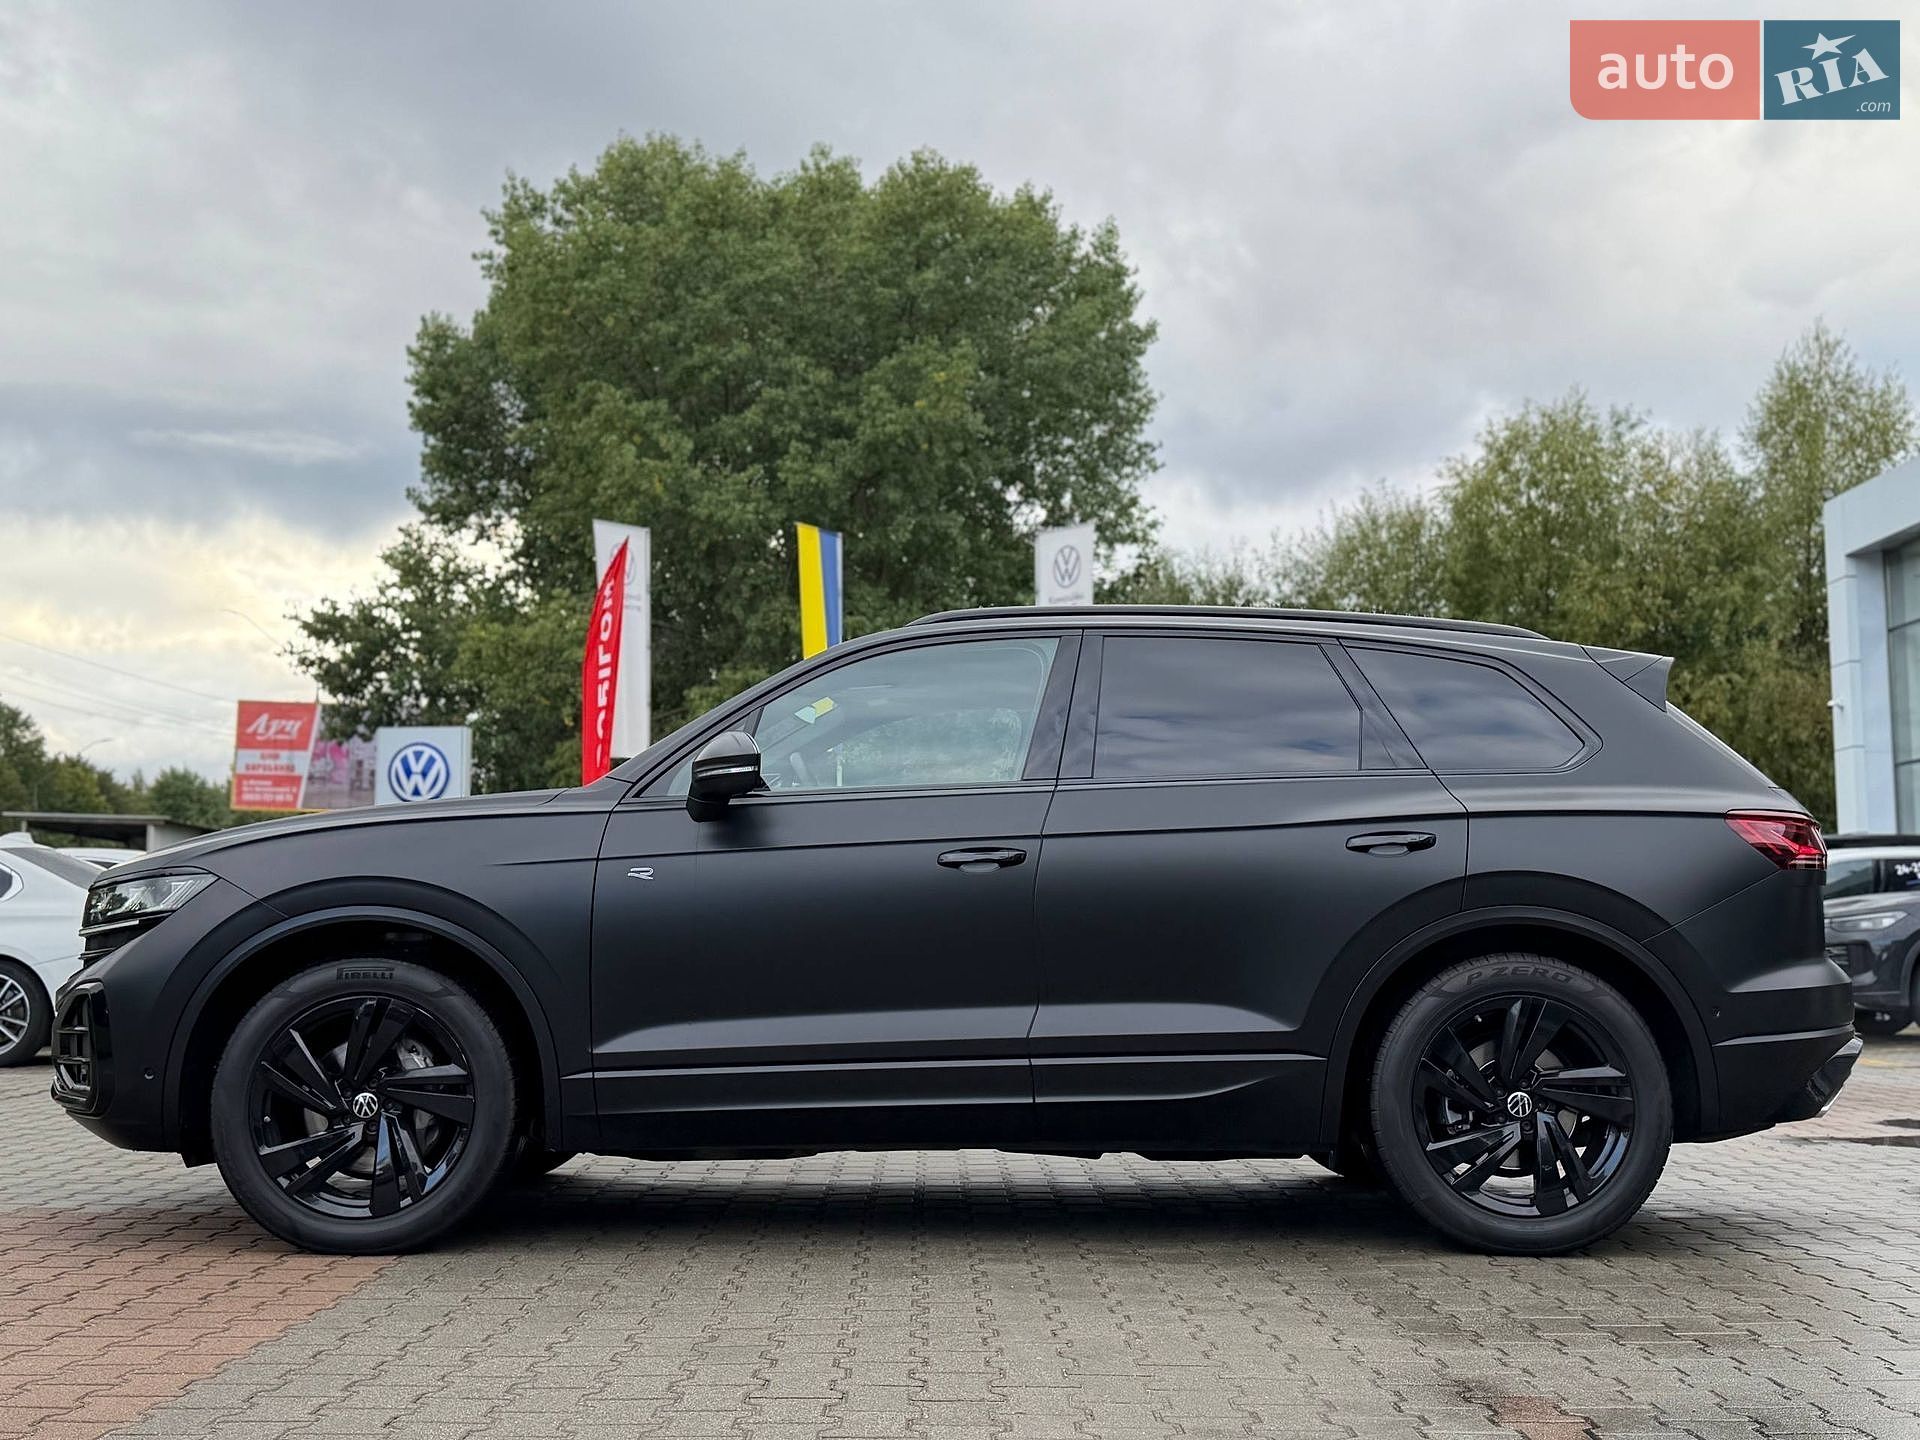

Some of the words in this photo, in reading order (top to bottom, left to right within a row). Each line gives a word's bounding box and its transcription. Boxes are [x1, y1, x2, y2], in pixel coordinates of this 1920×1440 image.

[388, 742, 450, 802] VW
[337, 966, 395, 980] PIRELLI
[1490, 966, 1573, 983] ZERO
